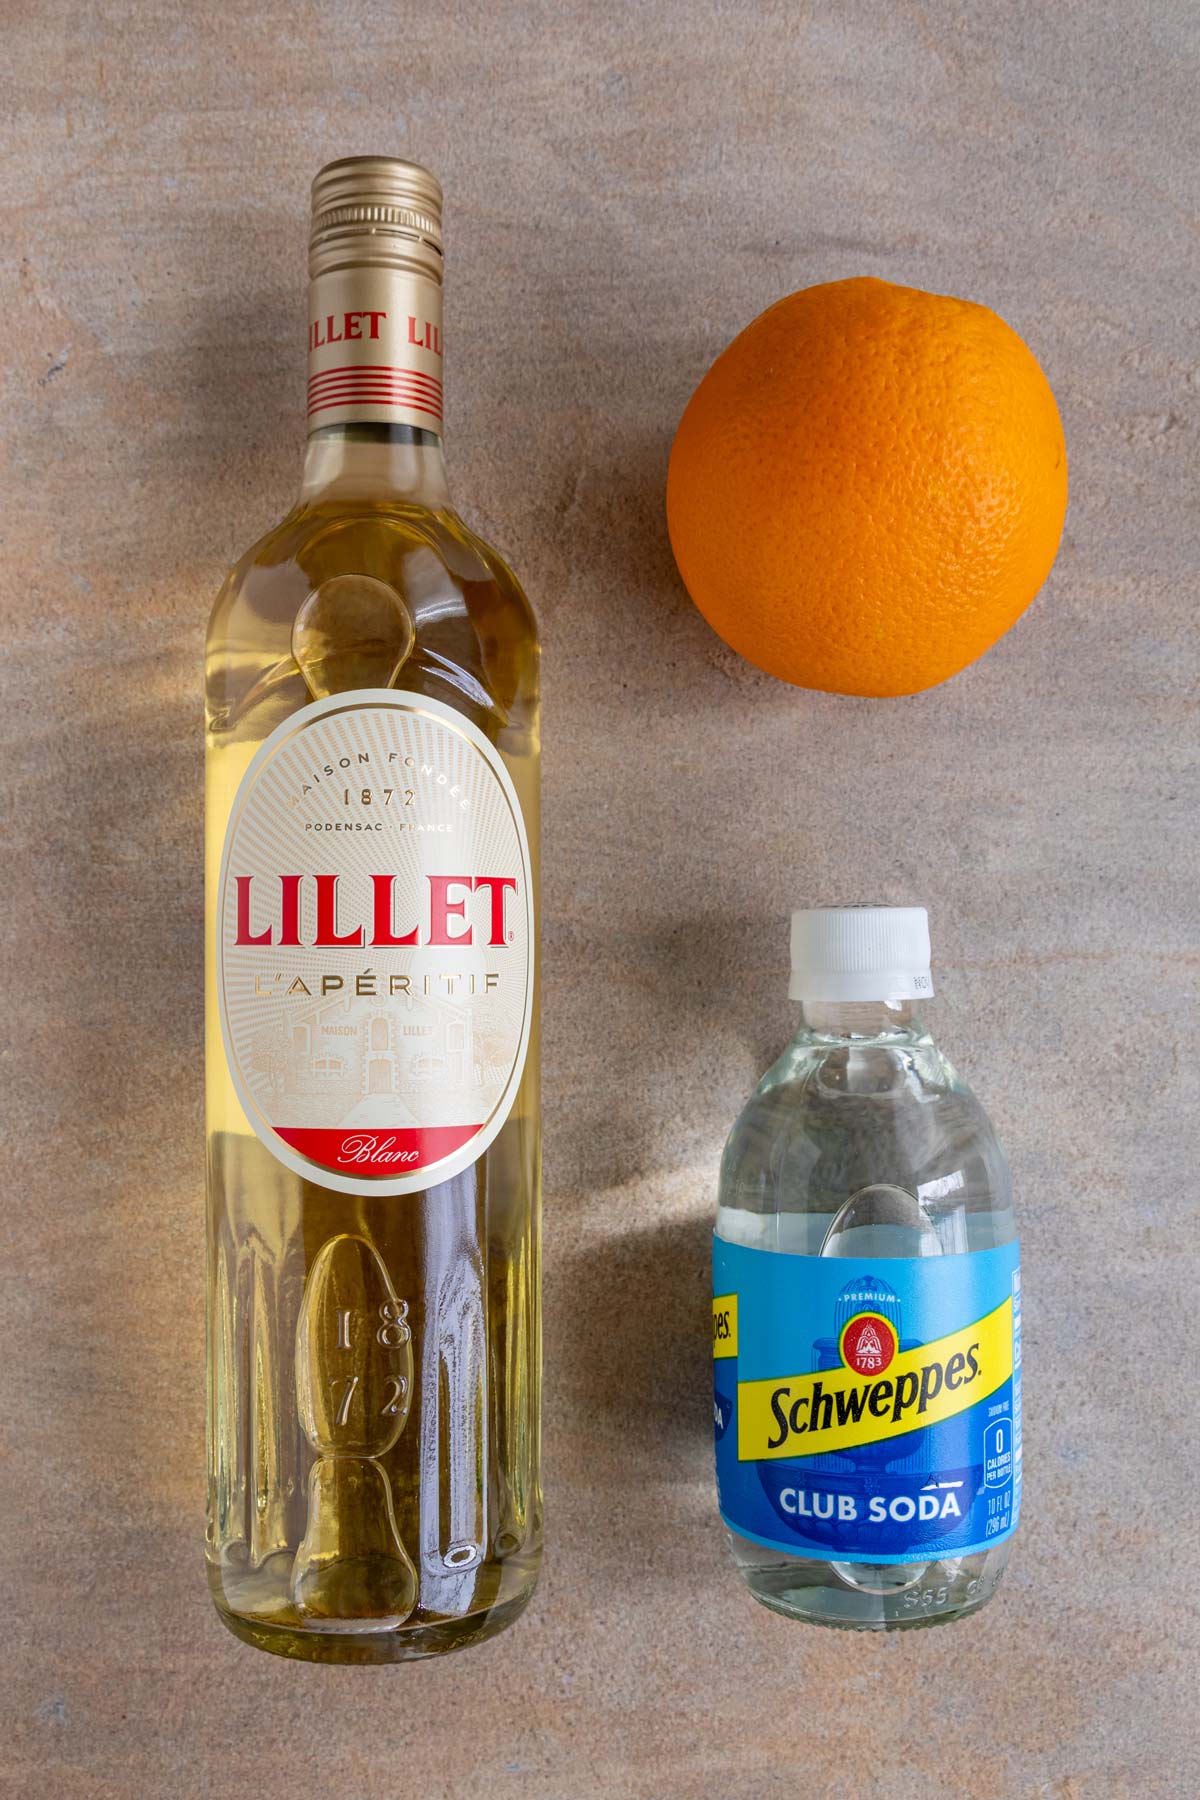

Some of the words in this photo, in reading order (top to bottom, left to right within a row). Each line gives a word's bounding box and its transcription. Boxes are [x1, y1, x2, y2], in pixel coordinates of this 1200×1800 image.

[309, 311, 387, 353] ILLET
[344, 788, 416, 806] 1872
[305, 823, 383, 832] PODENSAC
[400, 823, 454, 832] FRANCE
[337, 1134, 419, 1164] Blanc
[843, 1293, 895, 1303] PREMIUM
[856, 1356, 882, 1369] 1783
[779, 1488, 856, 1520] CLUB
[869, 1491, 961, 1522] SODA
